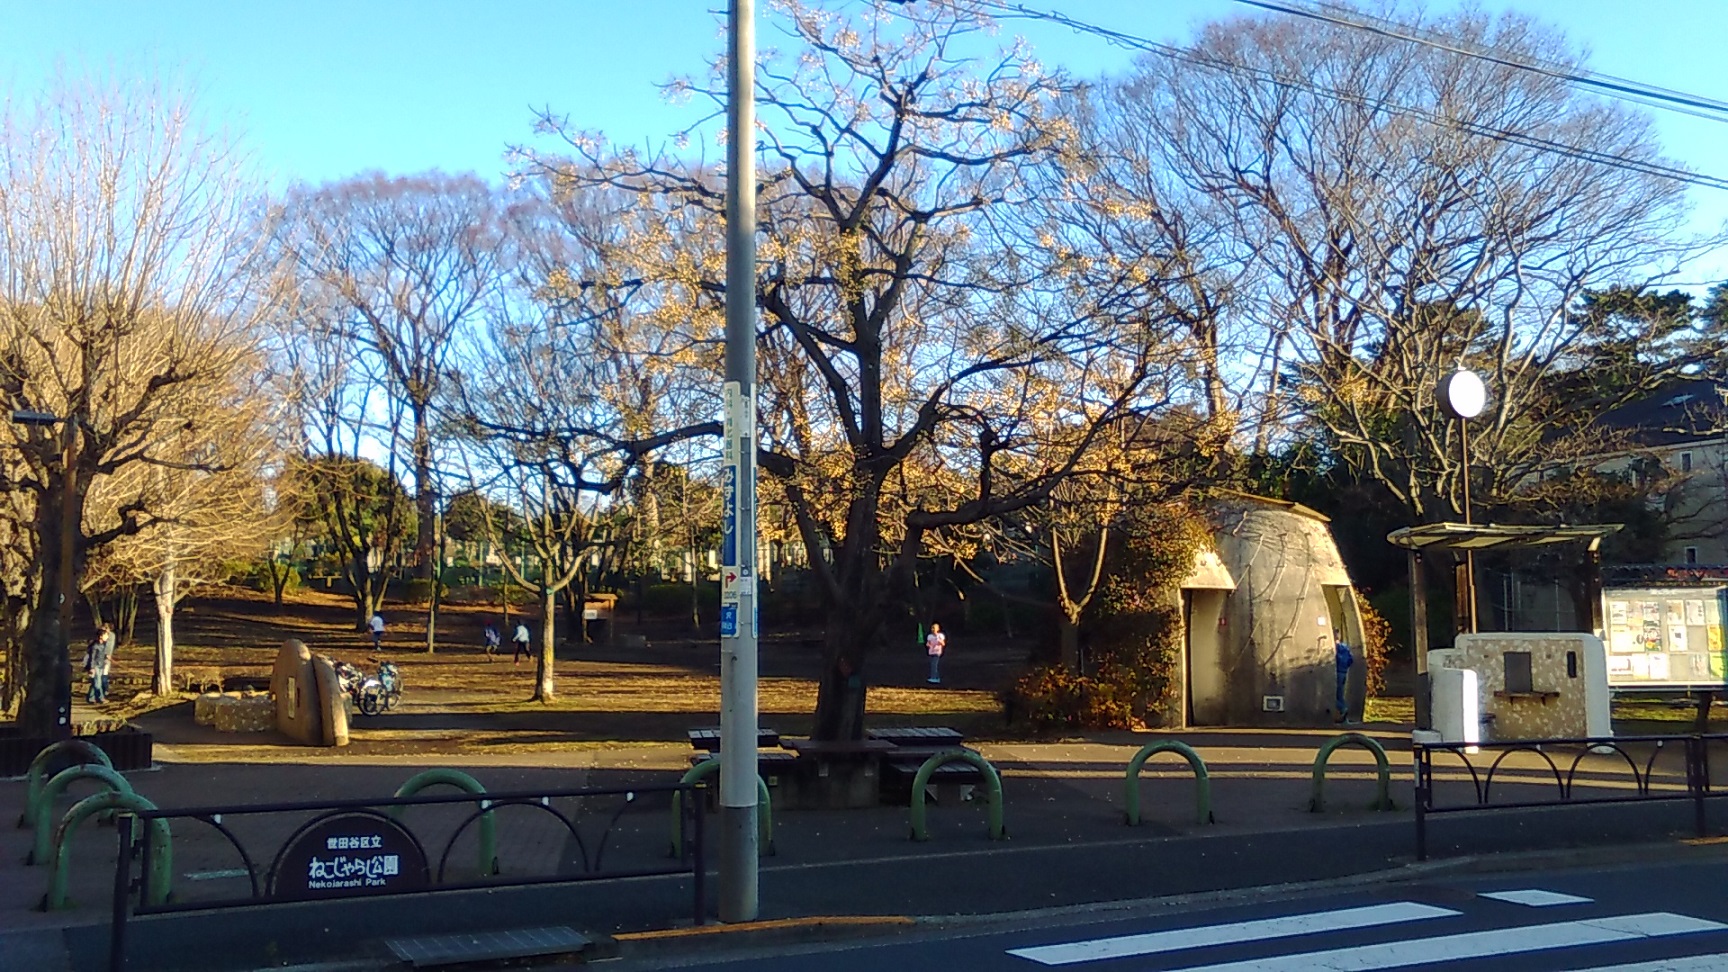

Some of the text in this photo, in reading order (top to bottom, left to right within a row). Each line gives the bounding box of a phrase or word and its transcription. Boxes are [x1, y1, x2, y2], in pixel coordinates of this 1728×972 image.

[327, 835, 382, 849] 世田谷区立
[309, 855, 399, 879] ねこじゃらし公園
[308, 878, 387, 889] Nekojarashi Park
